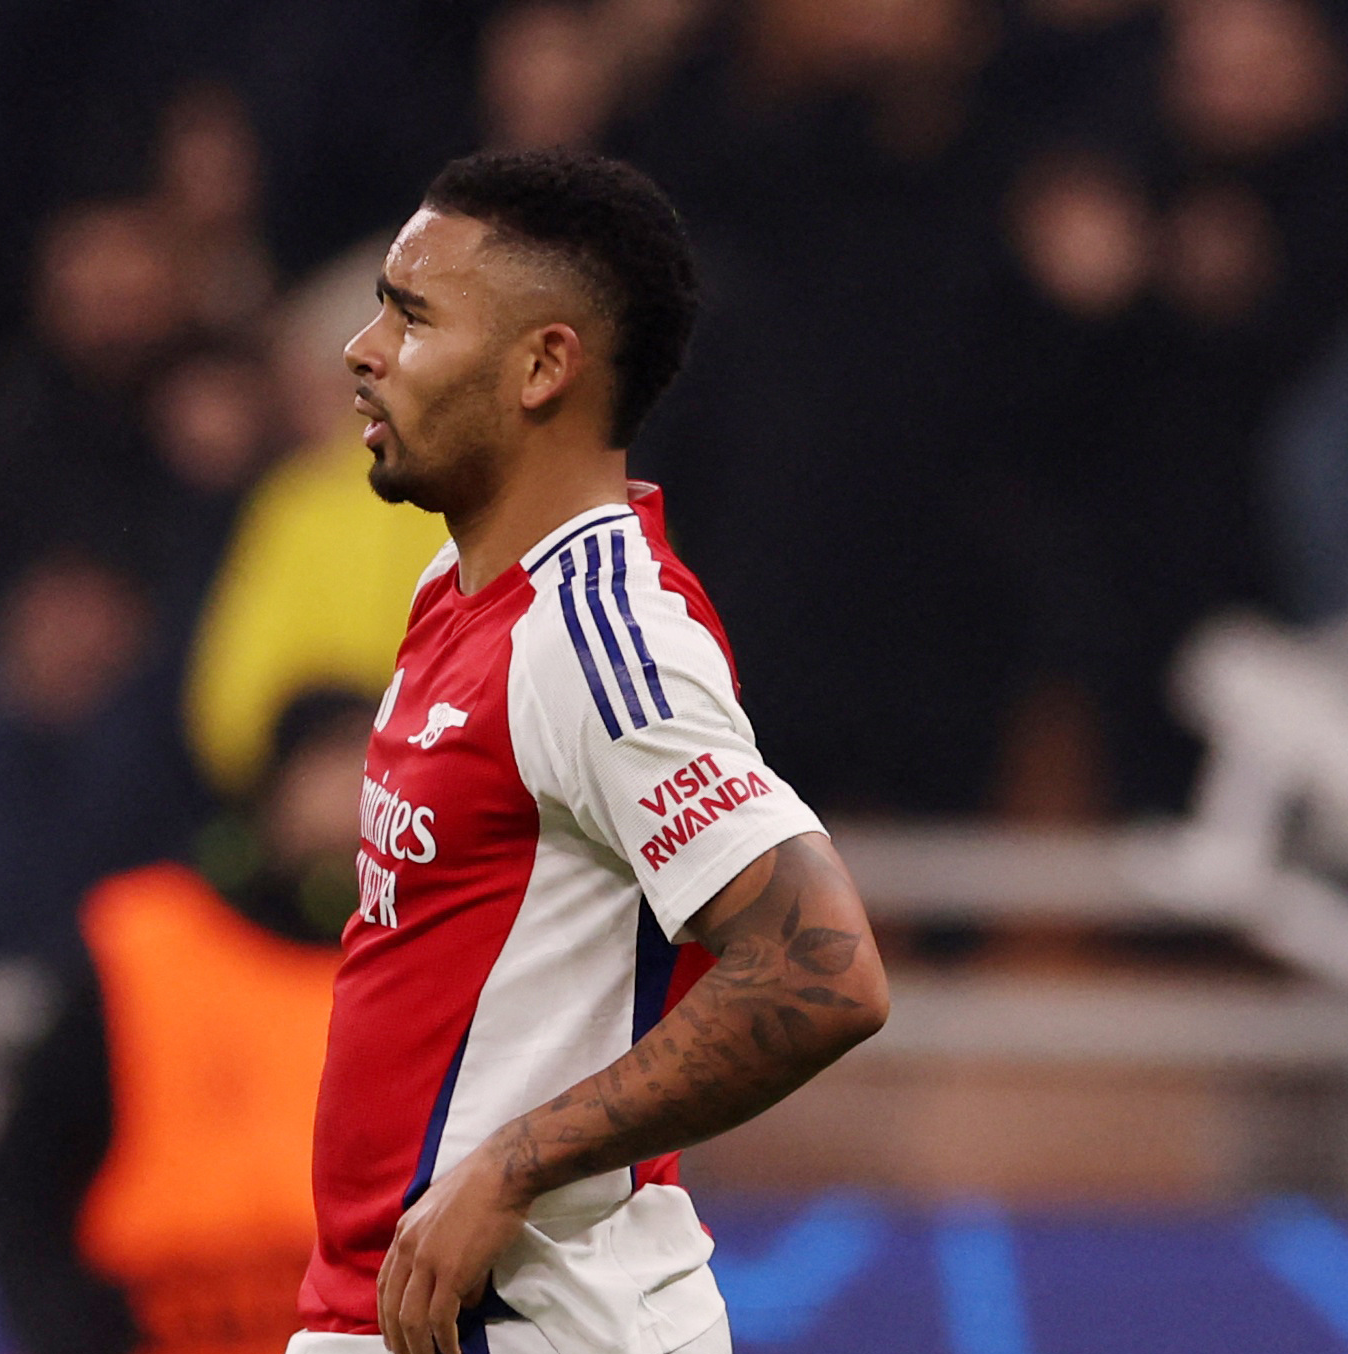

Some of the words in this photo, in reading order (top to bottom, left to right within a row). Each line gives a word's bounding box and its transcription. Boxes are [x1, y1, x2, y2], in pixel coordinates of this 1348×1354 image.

[359, 759, 437, 864] mirates
[638, 753, 723, 817] VISIT
[640, 771, 773, 872] RWANDA
